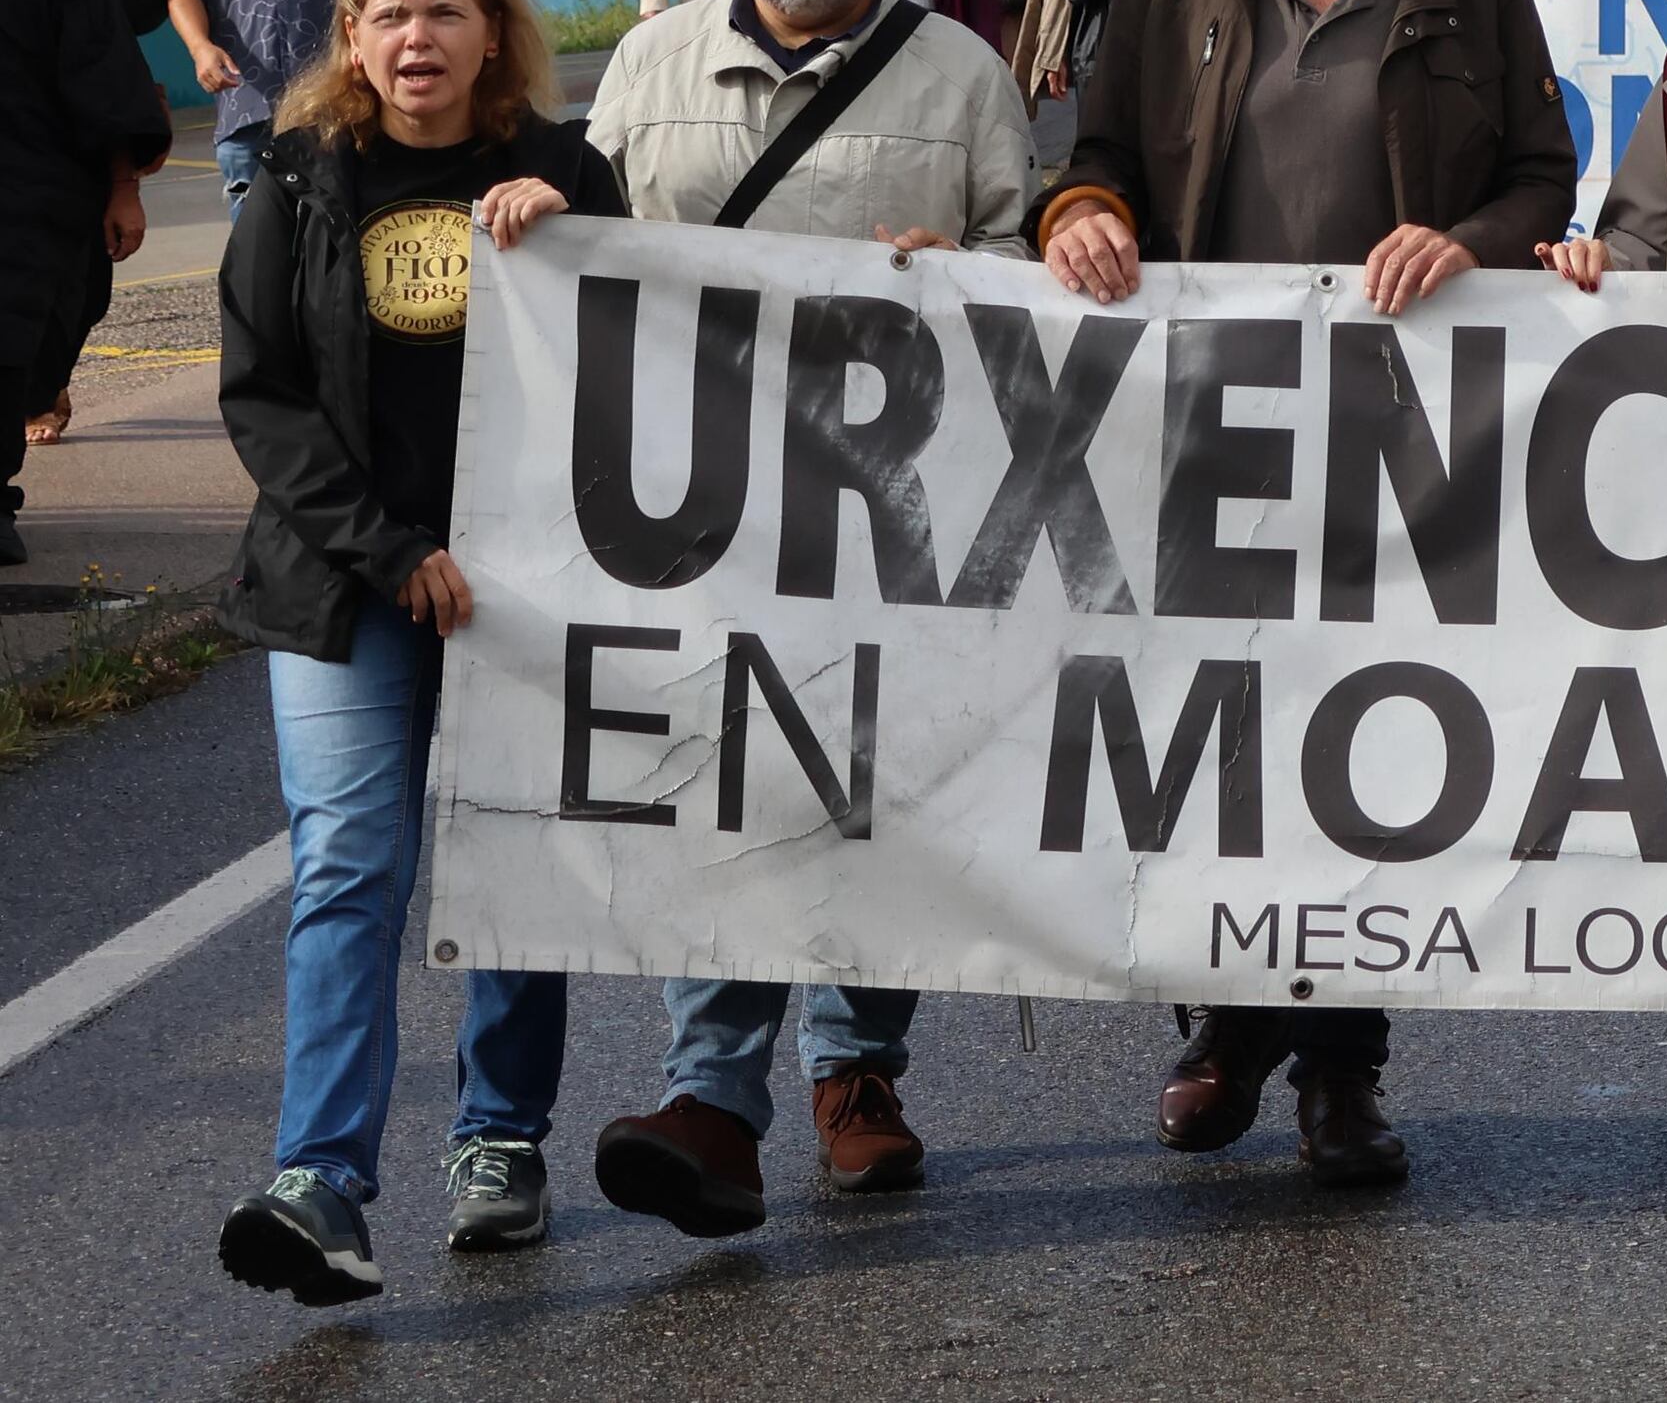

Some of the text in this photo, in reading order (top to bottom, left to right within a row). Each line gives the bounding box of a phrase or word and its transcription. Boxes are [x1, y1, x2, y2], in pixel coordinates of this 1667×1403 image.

[384, 239, 423, 257] 40
[384, 254, 470, 286] FIM
[403, 283, 468, 305] 1985
[556, 622, 881, 841] EN
[1210, 902, 1480, 973] MESA
